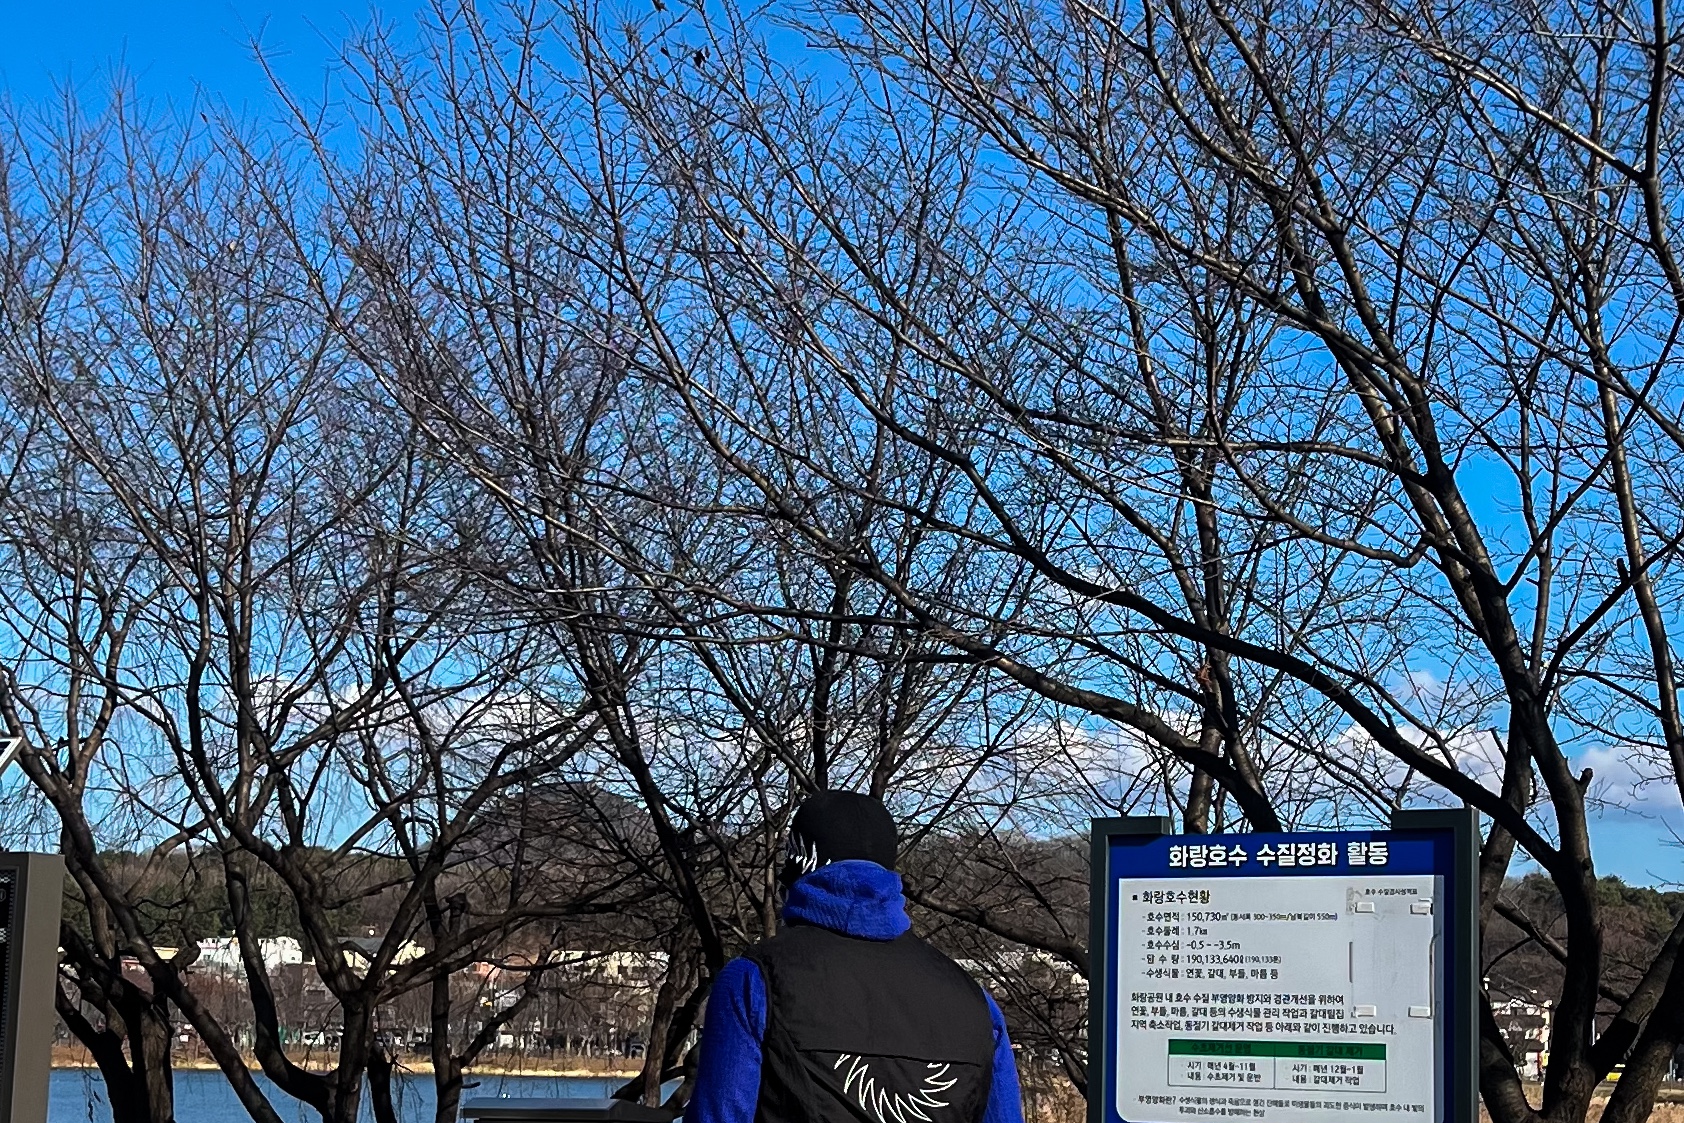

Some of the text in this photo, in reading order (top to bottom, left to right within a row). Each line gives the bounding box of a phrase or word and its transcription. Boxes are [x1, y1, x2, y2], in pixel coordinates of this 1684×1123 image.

[1169, 841, 1389, 867] 화랑호수 수질정화 활동
[1142, 889, 1211, 905] 화랑호수현황
[1146, 911, 1180, 922] 호수면적
[1146, 925, 1180, 936] 호수둘레
[1146, 939, 1180, 950] 호수수심
[1145, 968, 1179, 979] 수생식물
[1270, 969, 1279, 980] 등
[1165, 992, 1173, 1003] 내
[1175, 992, 1191, 1003] 호수
[1193, 992, 1209, 1003] 수질
[1318, 994, 1344, 1005] 위하여
[1191, 1006, 1207, 1017] 갈대
[1209, 1007, 1226, 1017] 등의
[1227, 1007, 1261, 1018] 수생식물
[1263, 1007, 1280, 1018] 관리
[1282, 1007, 1307, 1019] 작업과
[1131, 1019, 1147, 1030] 지역
[1246, 1021, 1263, 1032] 작업
[1265, 1021, 1273, 1032] 등
[1275, 1022, 1301, 1033] 아래와
[1303, 1022, 1320, 1033] 같이
[1322, 1023, 1357, 1034] 진행하고
[1359, 1023, 1397, 1035] 있습니다.
